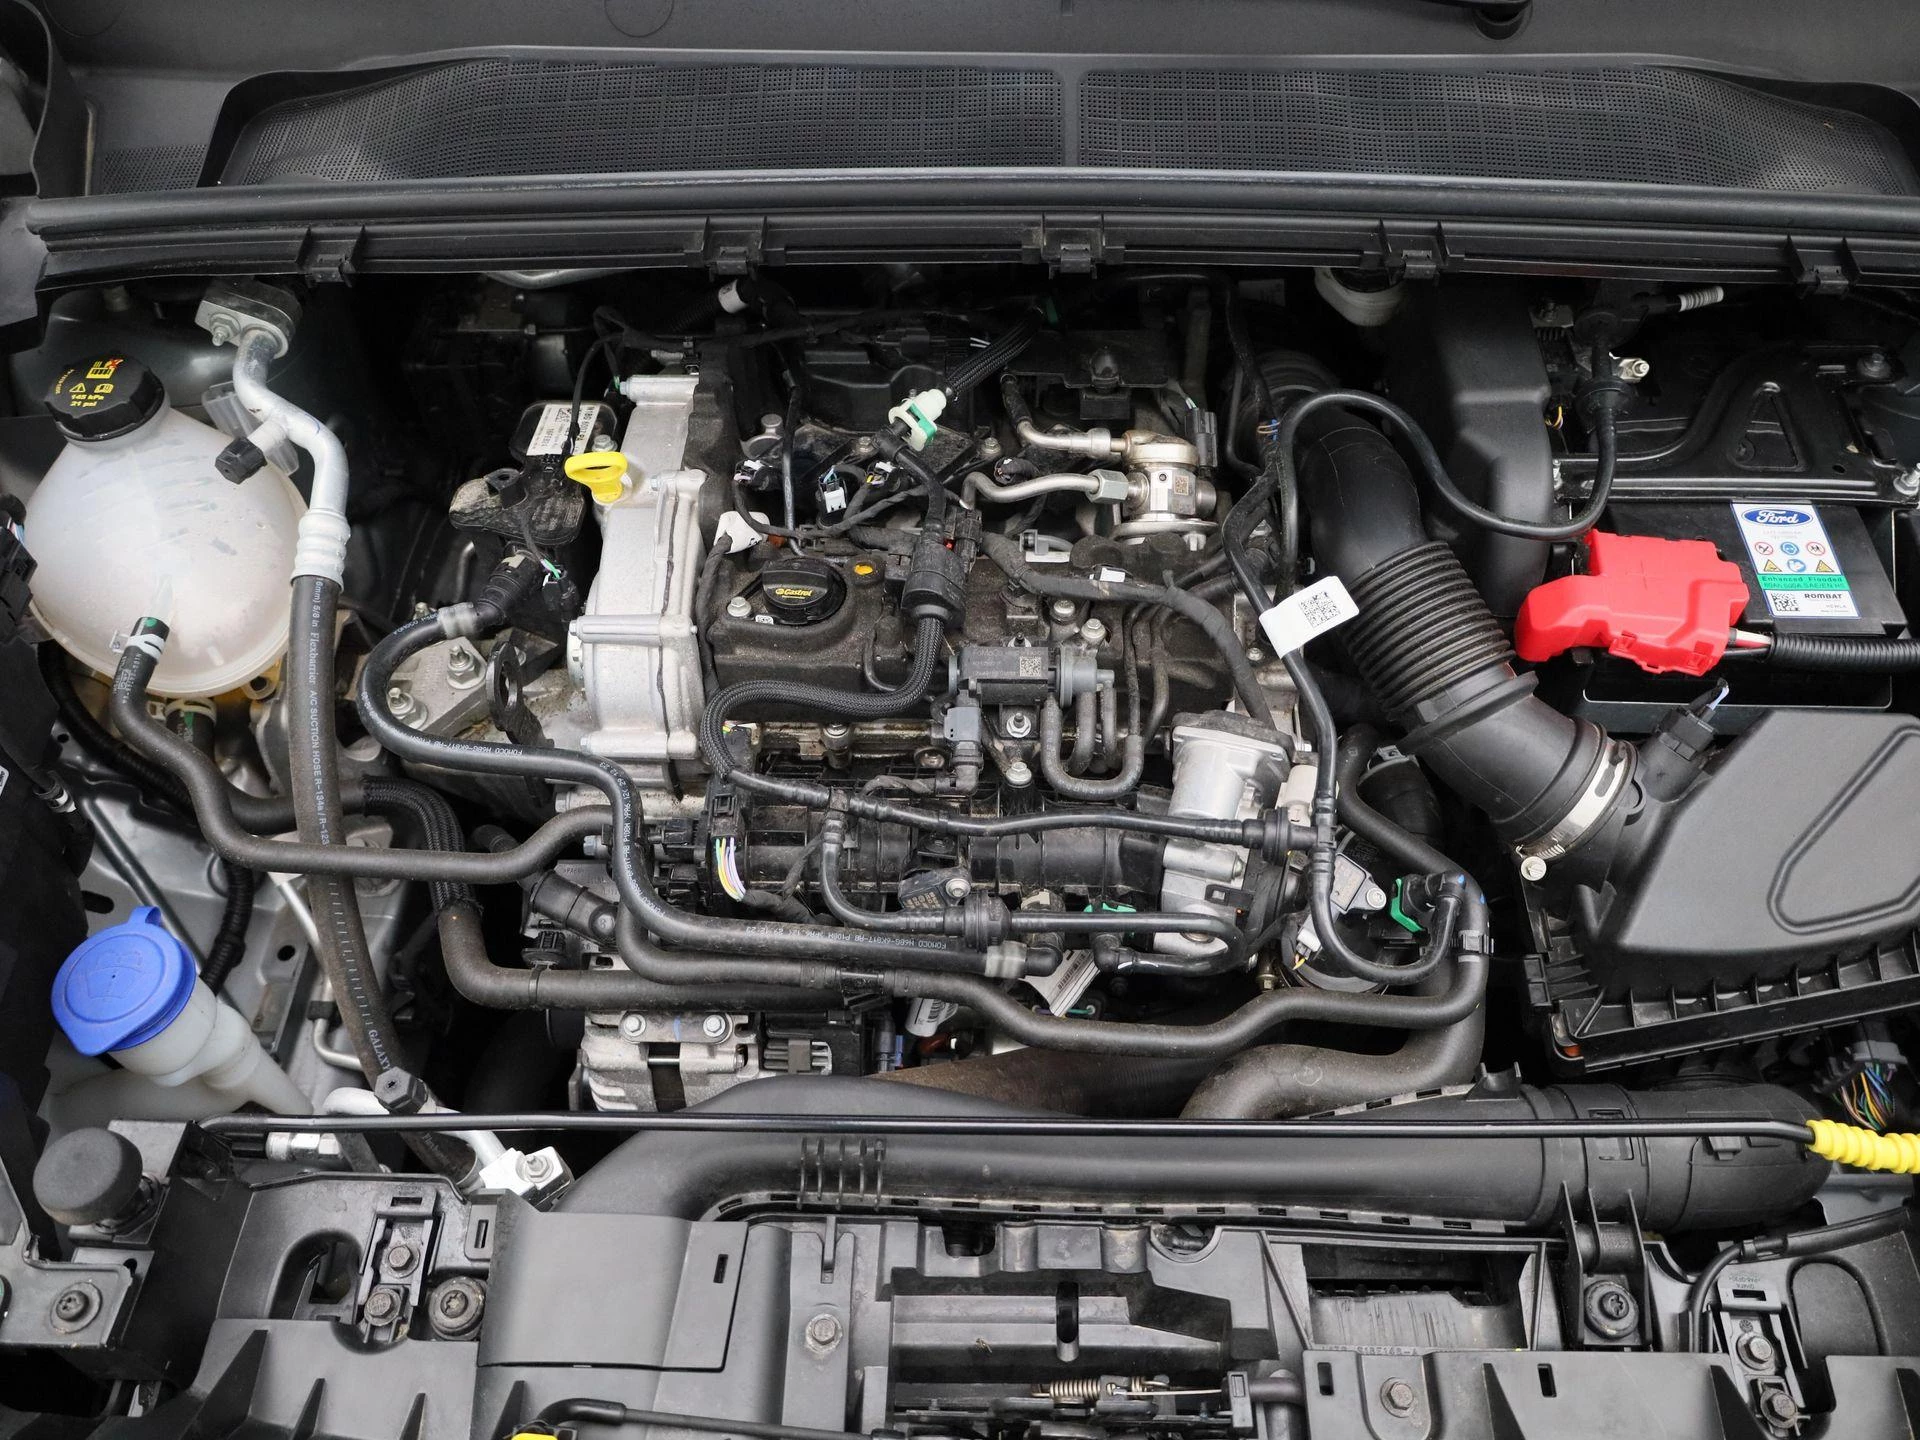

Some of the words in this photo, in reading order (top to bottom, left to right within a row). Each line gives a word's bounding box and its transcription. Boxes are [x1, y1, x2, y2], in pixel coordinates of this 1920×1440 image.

[1756, 510, 1799, 524] Ford
[308, 632, 320, 684] Flexbarrier
[310, 690, 318, 706] A/C
[310, 707, 319, 749] SUCTION
[313, 750, 322, 776] HOSE
[315, 778, 325, 811] R-134a
[369, 1030, 390, 1070] GALAXY
